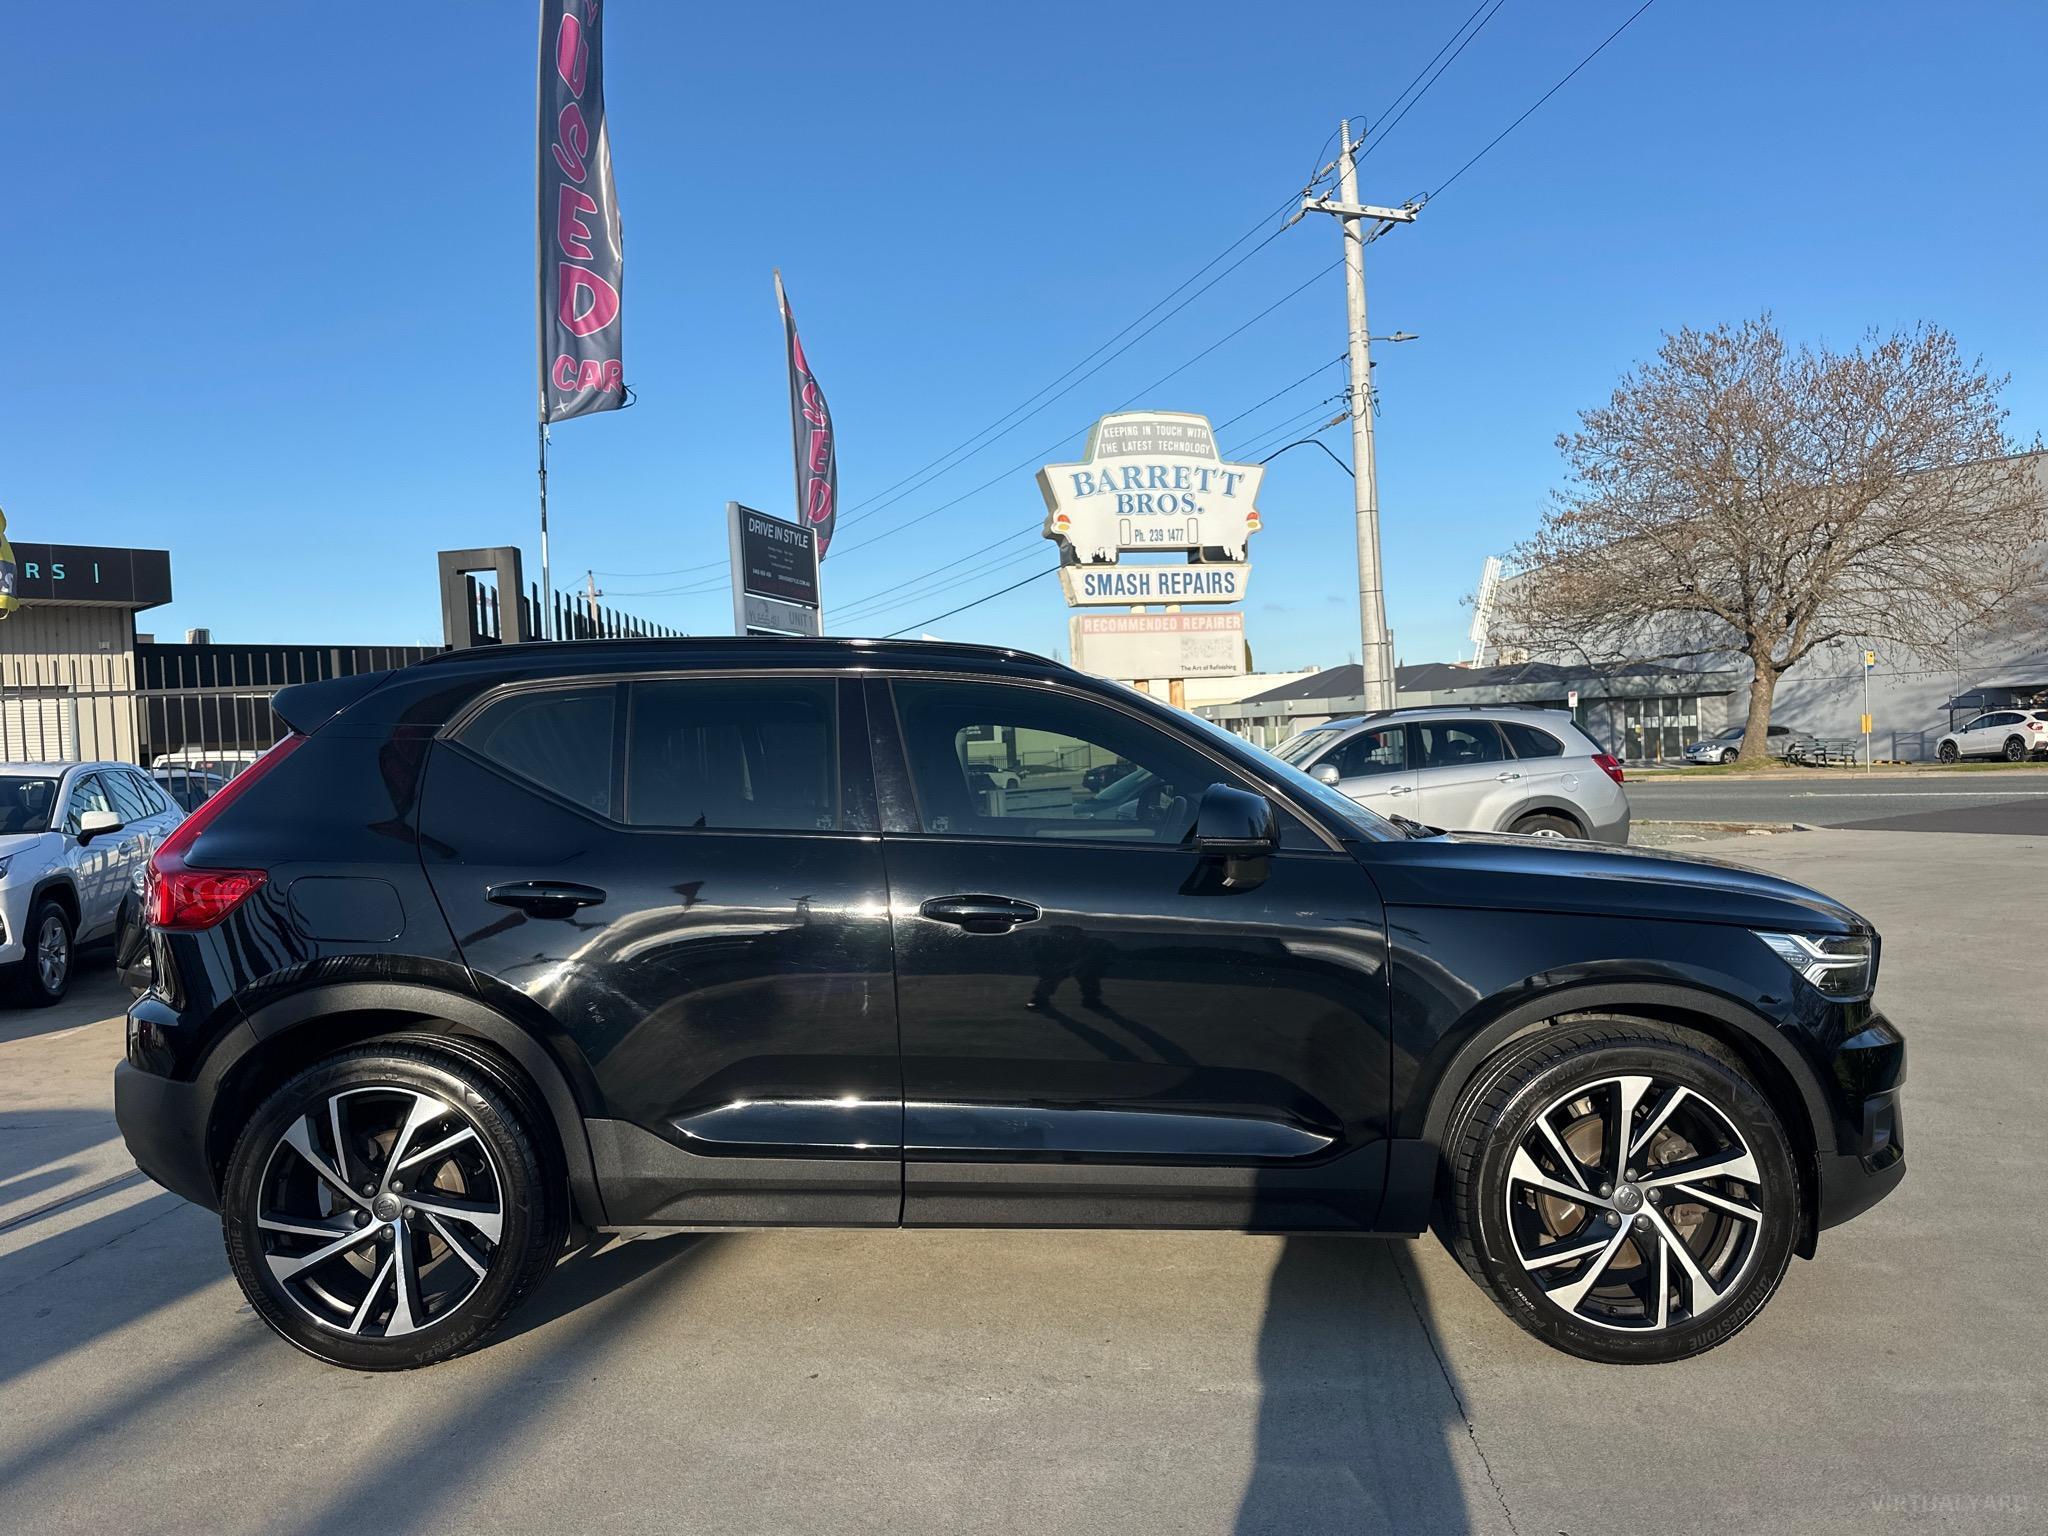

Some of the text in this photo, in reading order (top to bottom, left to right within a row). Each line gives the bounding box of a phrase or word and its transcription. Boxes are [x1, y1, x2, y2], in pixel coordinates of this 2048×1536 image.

[552, 12, 620, 338] USED
[1104, 425, 1207, 439] KEEPING IN TOUCH WITH
[1101, 440, 1210, 454] THE LATEST TECHNOLOGY
[1069, 465, 1245, 499] BARRETT
[1115, 492, 1204, 515] BROS.
[748, 517, 774, 539] DRIVE
[774, 525, 783, 541] IN
[783, 528, 809, 549] STYLE
[1134, 528, 1184, 543] Ph. 239 1477
[1084, 571, 1235, 597] SMASH REPAIRS
[1084, 615, 1241, 633] RECOMMENDED REPAIRER
[1687, 1272, 1772, 1351] BRIDGESTONE
